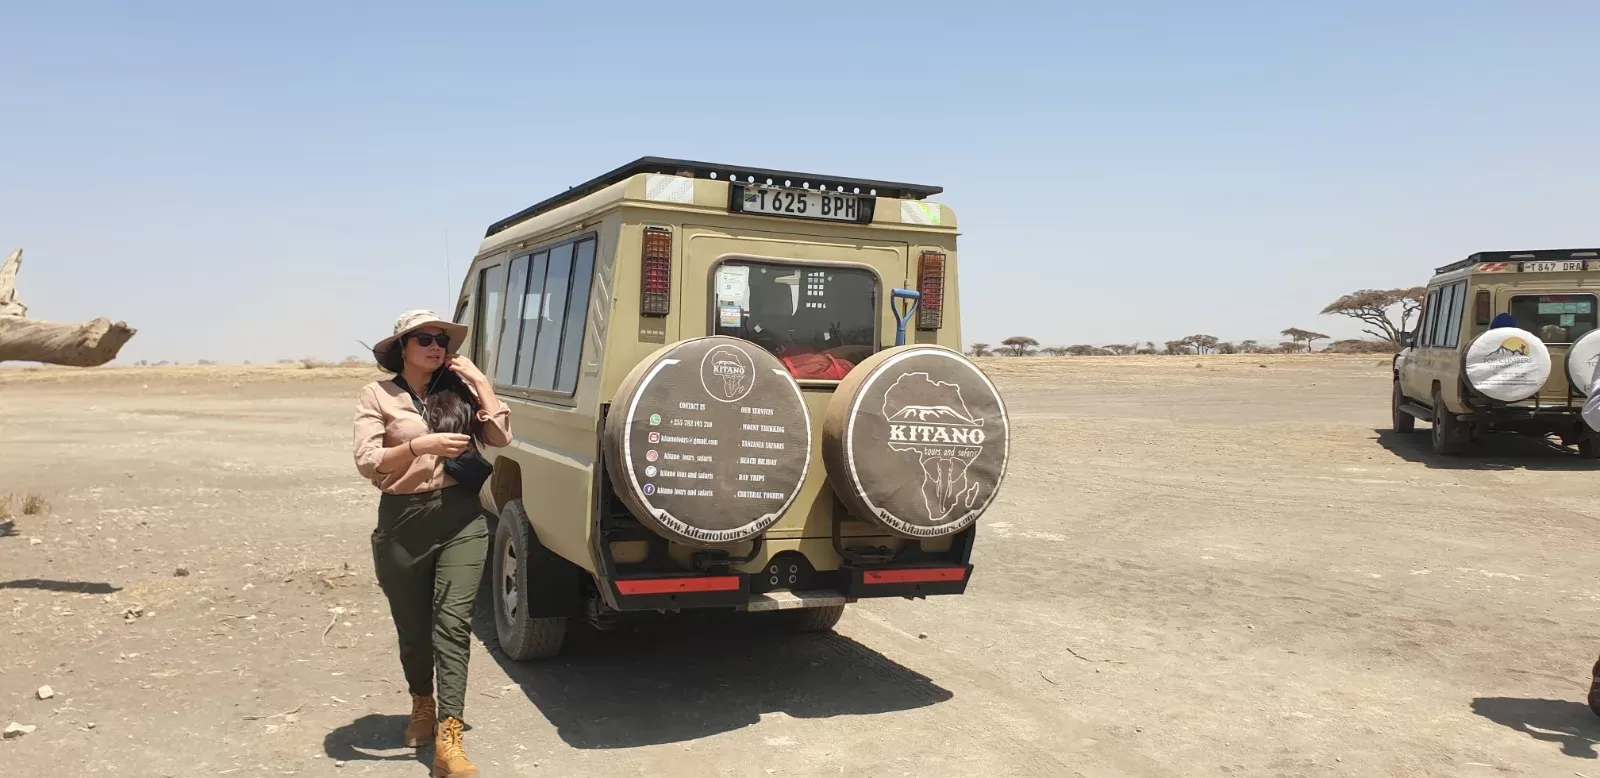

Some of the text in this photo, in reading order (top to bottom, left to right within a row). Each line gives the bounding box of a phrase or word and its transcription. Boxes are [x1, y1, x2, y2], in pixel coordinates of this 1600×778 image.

[758, 189, 856, 218] T 625 BPH
[1538, 263, 1556, 271] 847
[1563, 262, 1581, 270] DRA
[713, 365, 745, 375] KITANO
[740, 406, 751, 414] OUR
[889, 424, 986, 444] KITANO
[924, 447, 977, 458] tours and safaris
[660, 512, 772, 541] www.kitanotours.com
[880, 510, 976, 536] www.kitanotours.com
